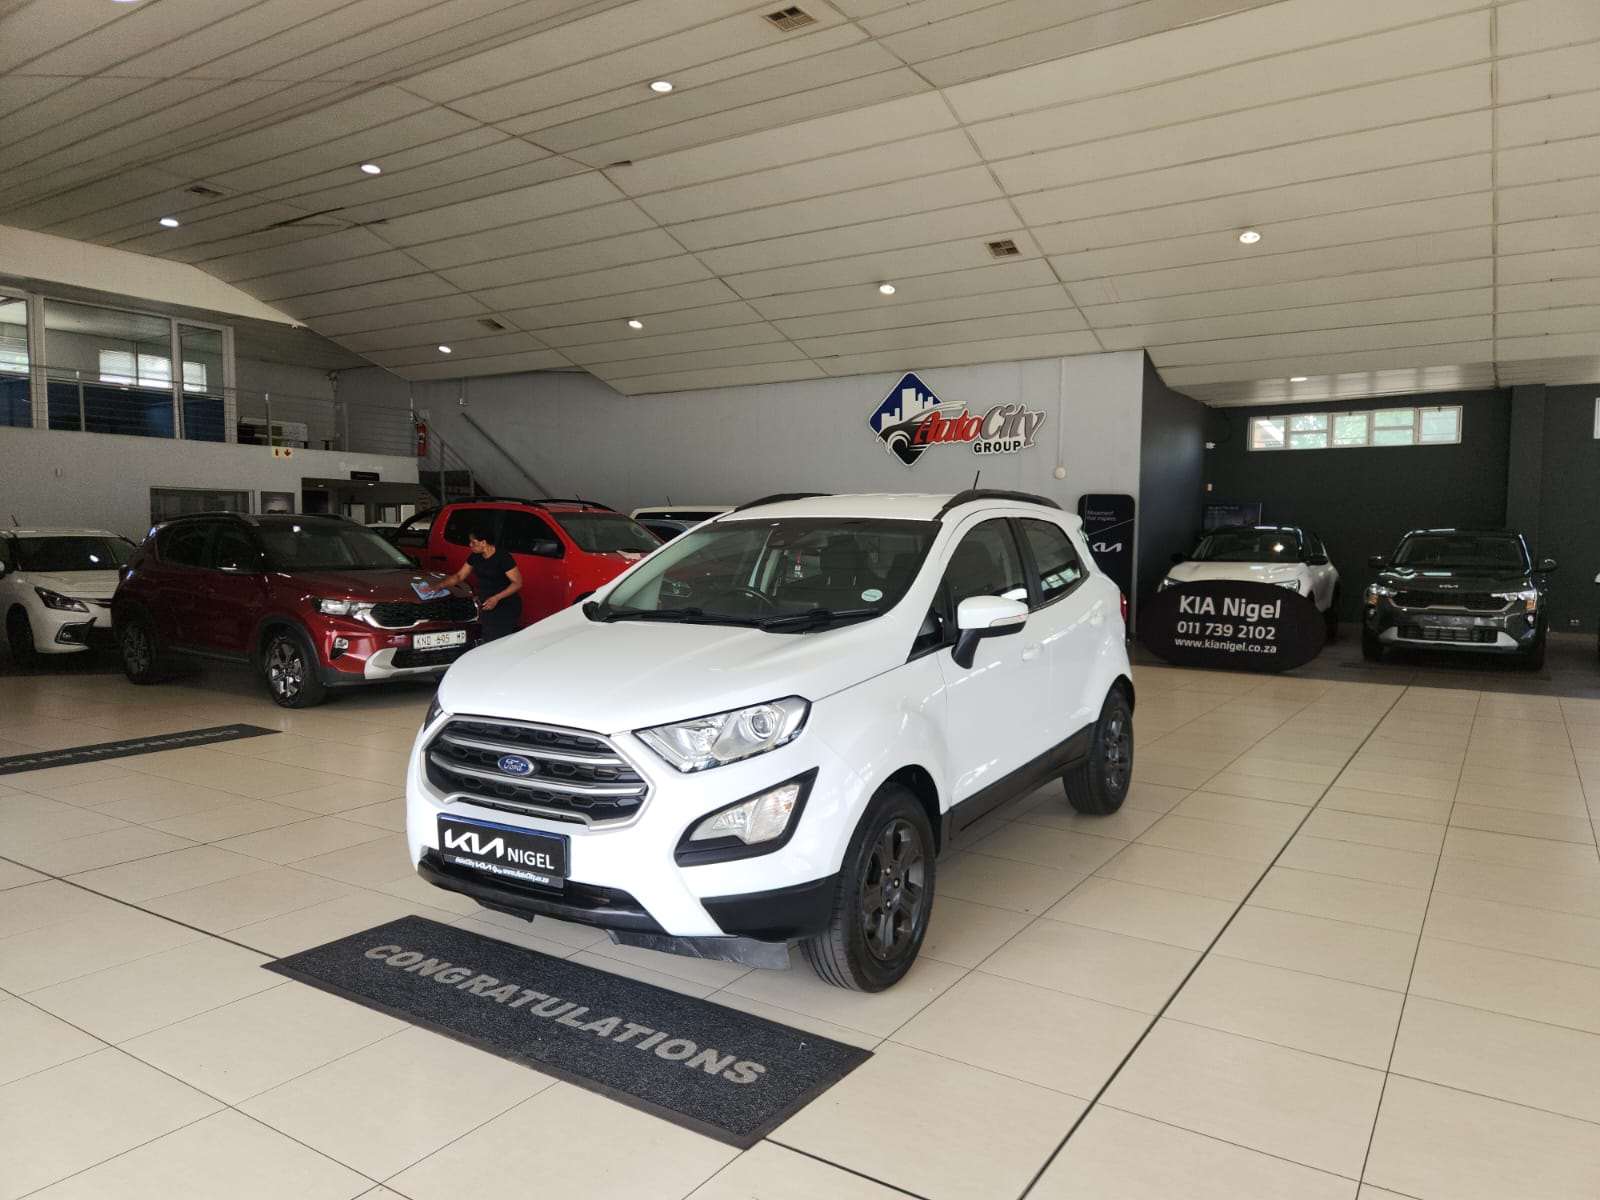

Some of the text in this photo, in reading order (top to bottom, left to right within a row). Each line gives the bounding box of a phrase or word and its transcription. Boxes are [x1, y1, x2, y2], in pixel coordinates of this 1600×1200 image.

[973, 440, 1022, 454] GROUP
[1179, 595, 1281, 622] KIA Nigel
[1177, 621, 1276, 640] 011 739 2102
[1175, 637, 1277, 655] www.kianigel.co.za
[503, 758, 526, 772] Ford
[444, 828, 555, 870] KIA NIGEL
[364, 943, 767, 1086] CONGRATULATIONS
